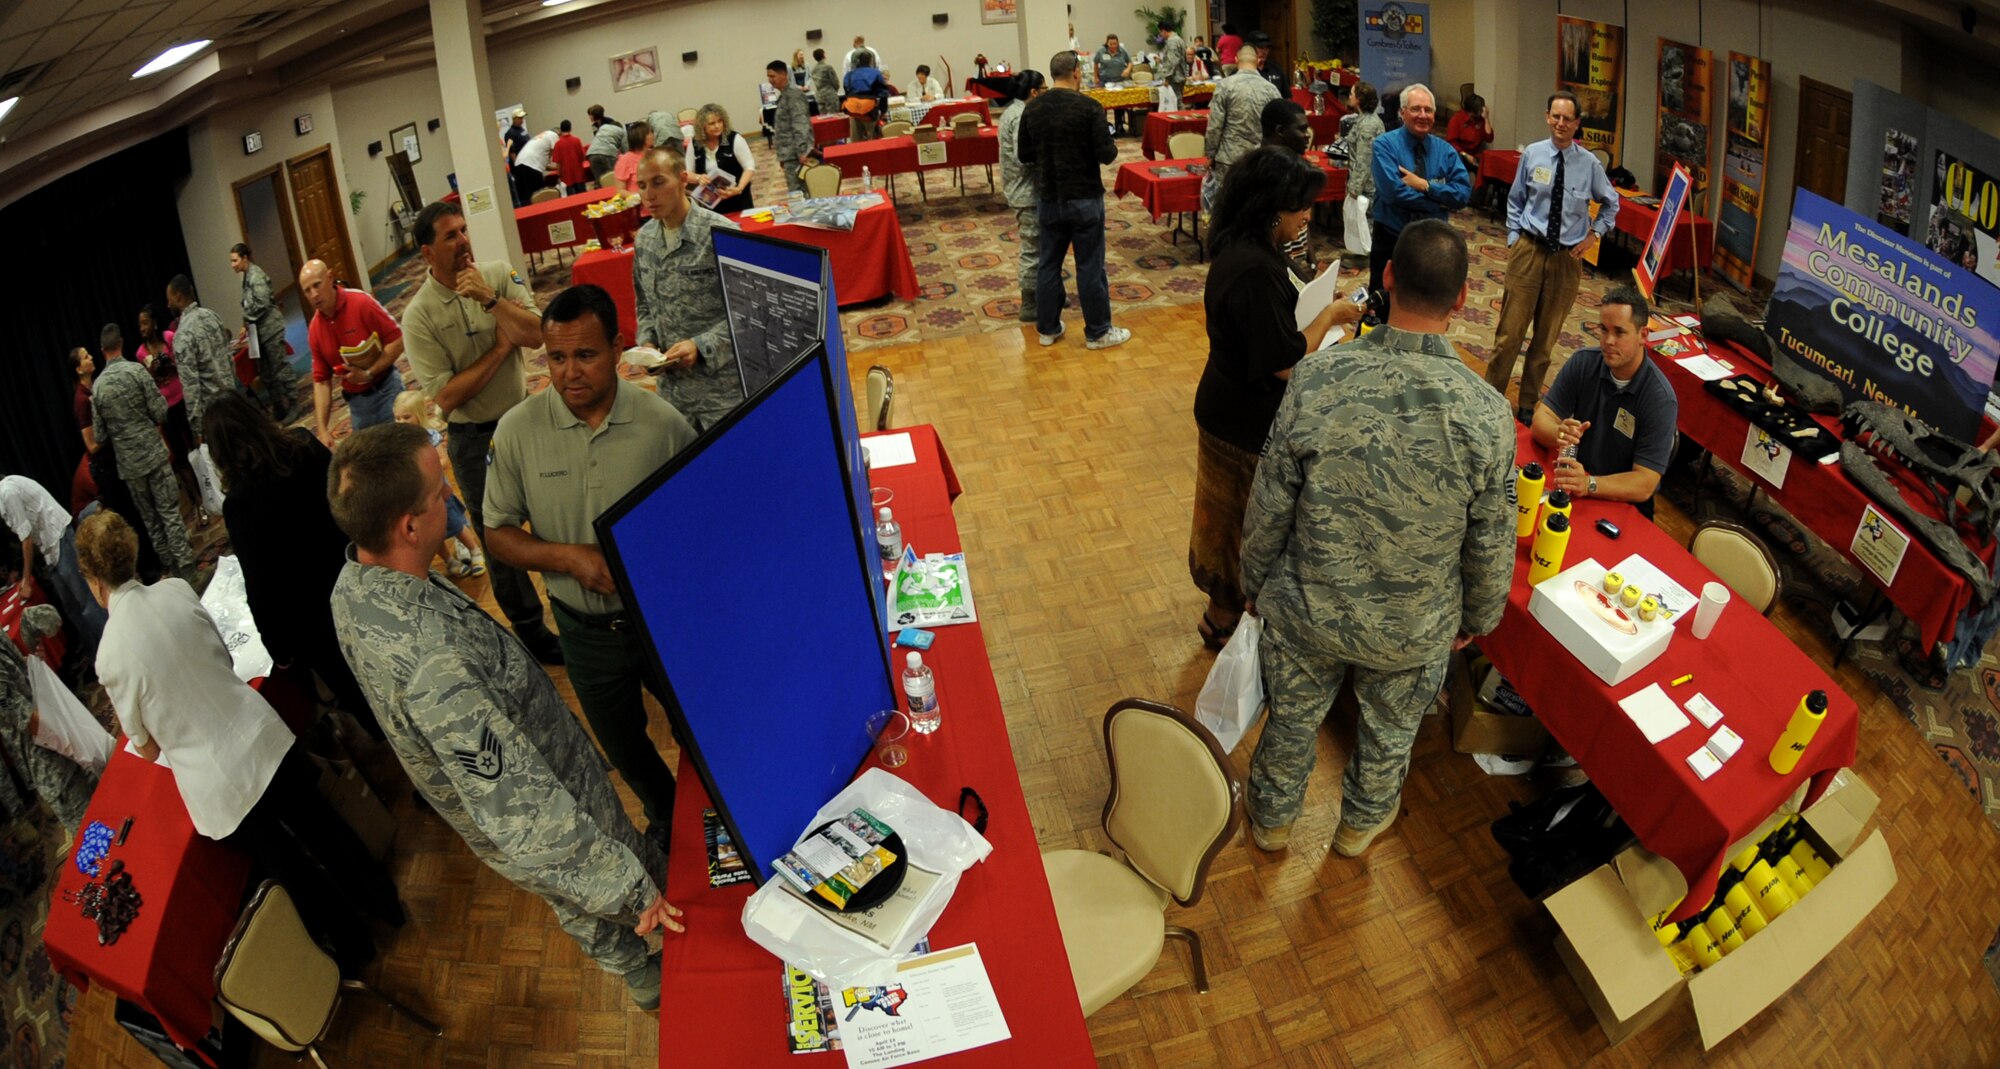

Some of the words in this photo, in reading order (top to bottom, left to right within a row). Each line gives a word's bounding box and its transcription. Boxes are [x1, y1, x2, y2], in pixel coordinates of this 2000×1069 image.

[1592, 41, 1599, 49] of
[1591, 64, 1599, 73] to
[1855, 222, 1866, 234] The
[1867, 229, 1895, 248] Dinosaur
[1895, 243, 1923, 263] Museum
[1929, 263, 1944, 276] part
[1943, 271, 1952, 279] of
[1816, 222, 1977, 328] Mesalands
[1808, 250, 1973, 363] Community
[1830, 297, 1934, 376] College
[1780, 327, 1857, 389] Tucumcari,
[1862, 378, 1898, 408] New
[859, 1022, 888, 1033] Discover
[890, 1018, 907, 1026] what
[865, 1030, 881, 1040] close
[892, 1023, 913, 1033] home!
[884, 1048, 905, 1056] Landing
